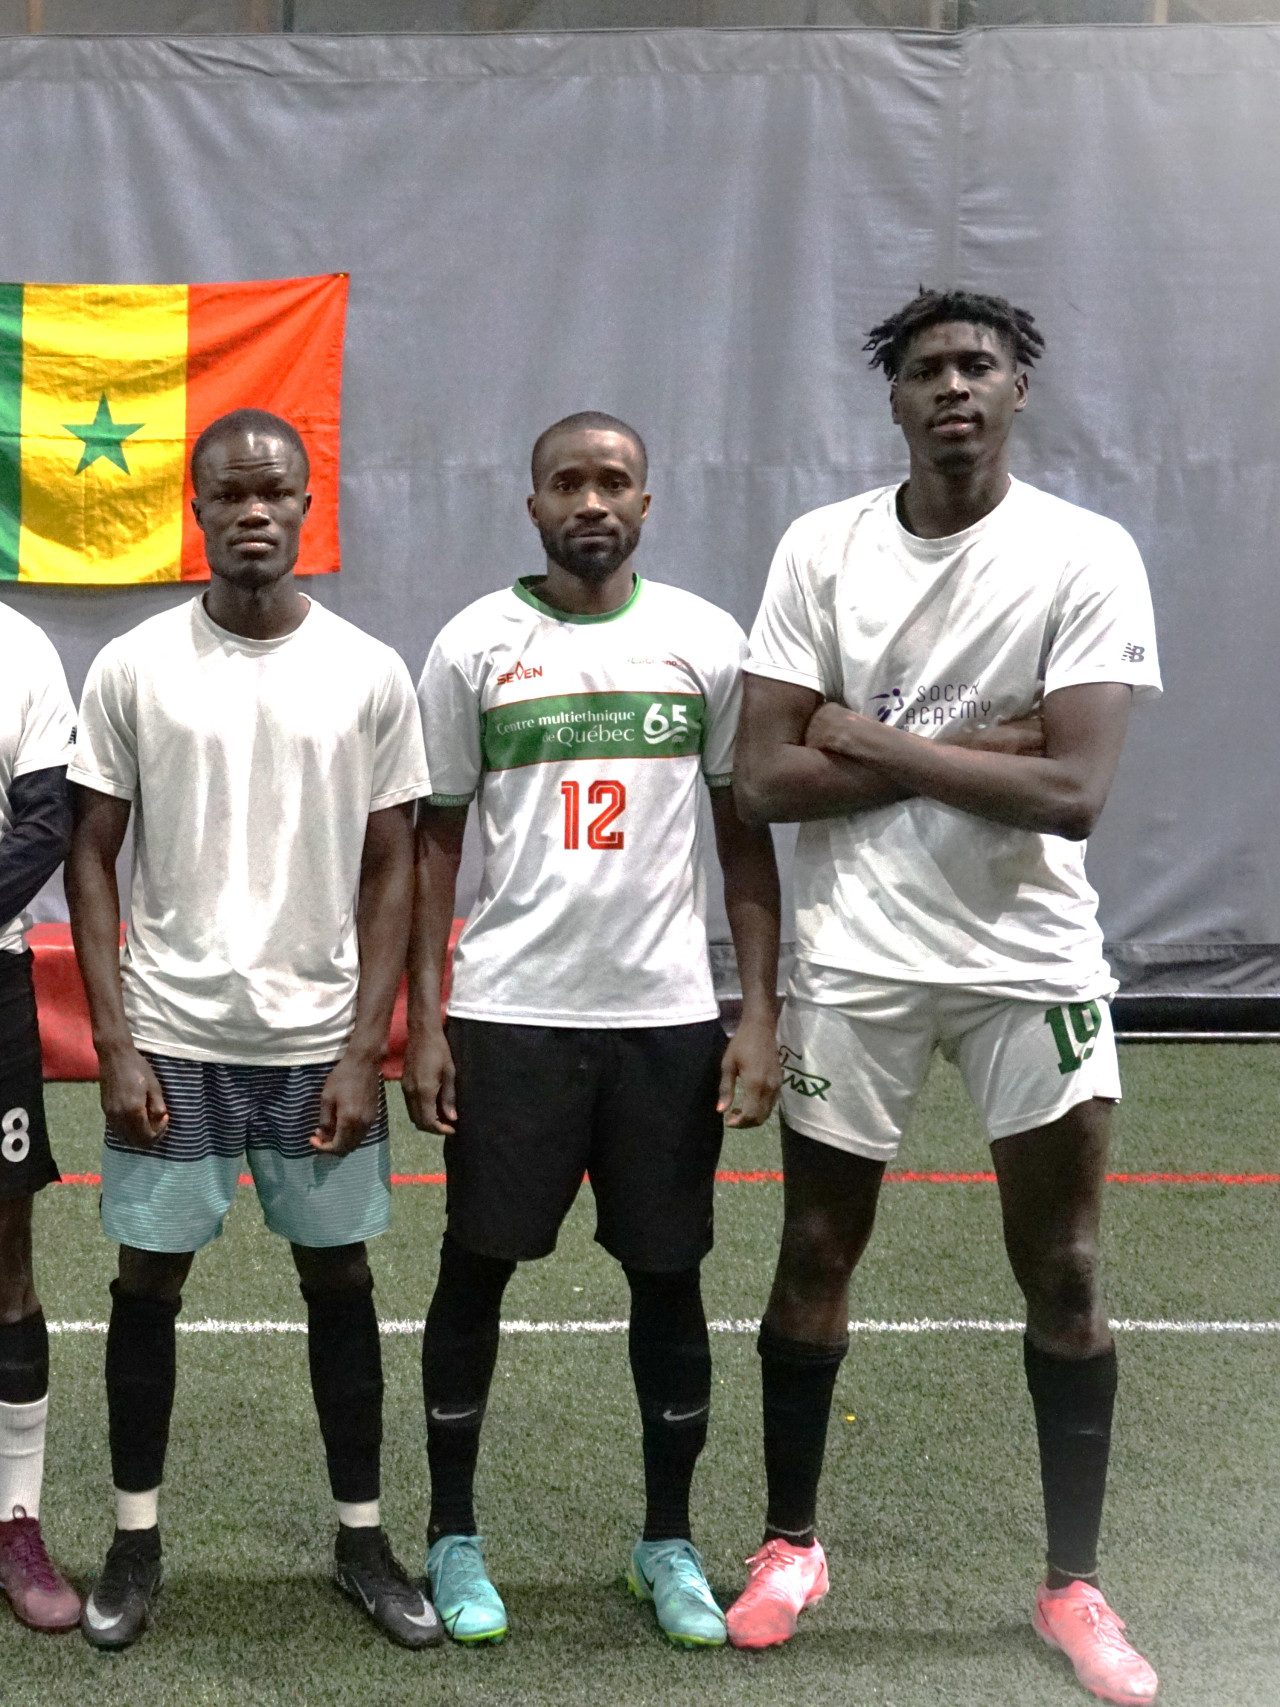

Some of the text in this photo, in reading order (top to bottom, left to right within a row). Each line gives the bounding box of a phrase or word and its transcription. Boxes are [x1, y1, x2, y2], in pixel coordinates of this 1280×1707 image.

[496, 660, 543, 686] SEVEN
[915, 679, 980, 703] SOCC
[496, 709, 636, 736] Centre multiethnique
[643, 703, 688, 737] 65
[905, 700, 991, 725] ACAMY
[543, 724, 636, 748] de Québec
[560, 780, 626, 850] 12
[0, 1107, 30, 1163] 8
